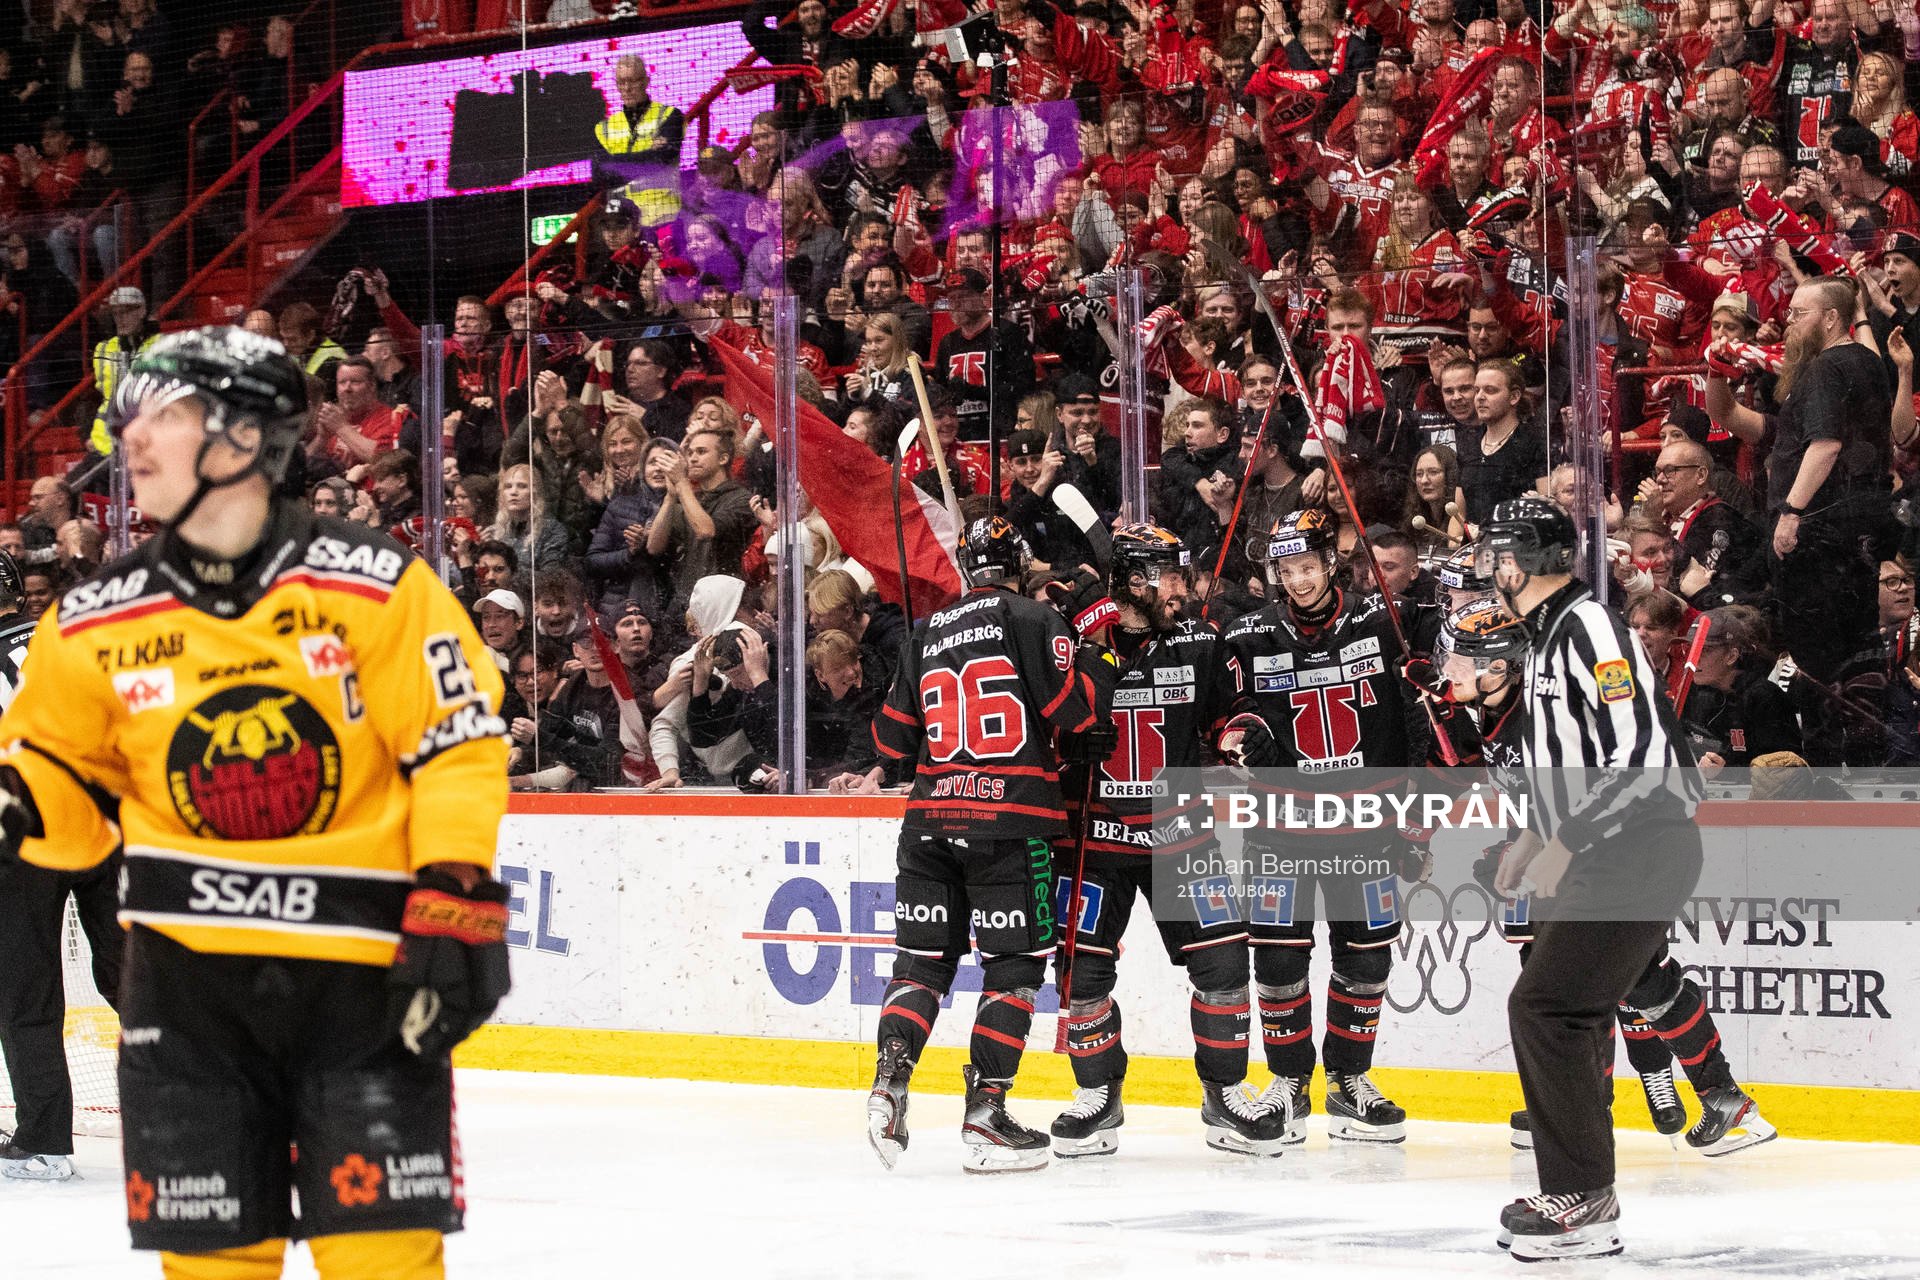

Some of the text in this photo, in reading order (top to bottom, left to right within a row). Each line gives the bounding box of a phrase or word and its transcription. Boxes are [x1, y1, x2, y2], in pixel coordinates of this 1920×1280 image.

[304, 535, 402, 582] SSAB
[60, 568, 149, 619] SSAB
[1165, 631, 1217, 647] NÄRKE KÖTT
[118, 633, 185, 667] LKAB
[1341, 641, 1377, 657] NASTA
[1156, 668, 1192, 680] NASTA
[1350, 659, 1376, 675] OBK
[1269, 677, 1293, 688] BRL
[1162, 687, 1189, 700] OBK
[1360, 679, 1378, 708] A
[919, 655, 1027, 763] 96
[1302, 756, 1359, 773] ÖREBRO
[931, 771, 1005, 800] KOVÁCS
[1105, 783, 1164, 796] ÖREBRO
[189, 868, 319, 922] SSAB
[1027, 838, 1056, 942] mTech
[1069, 1032, 1116, 1049] STILL
